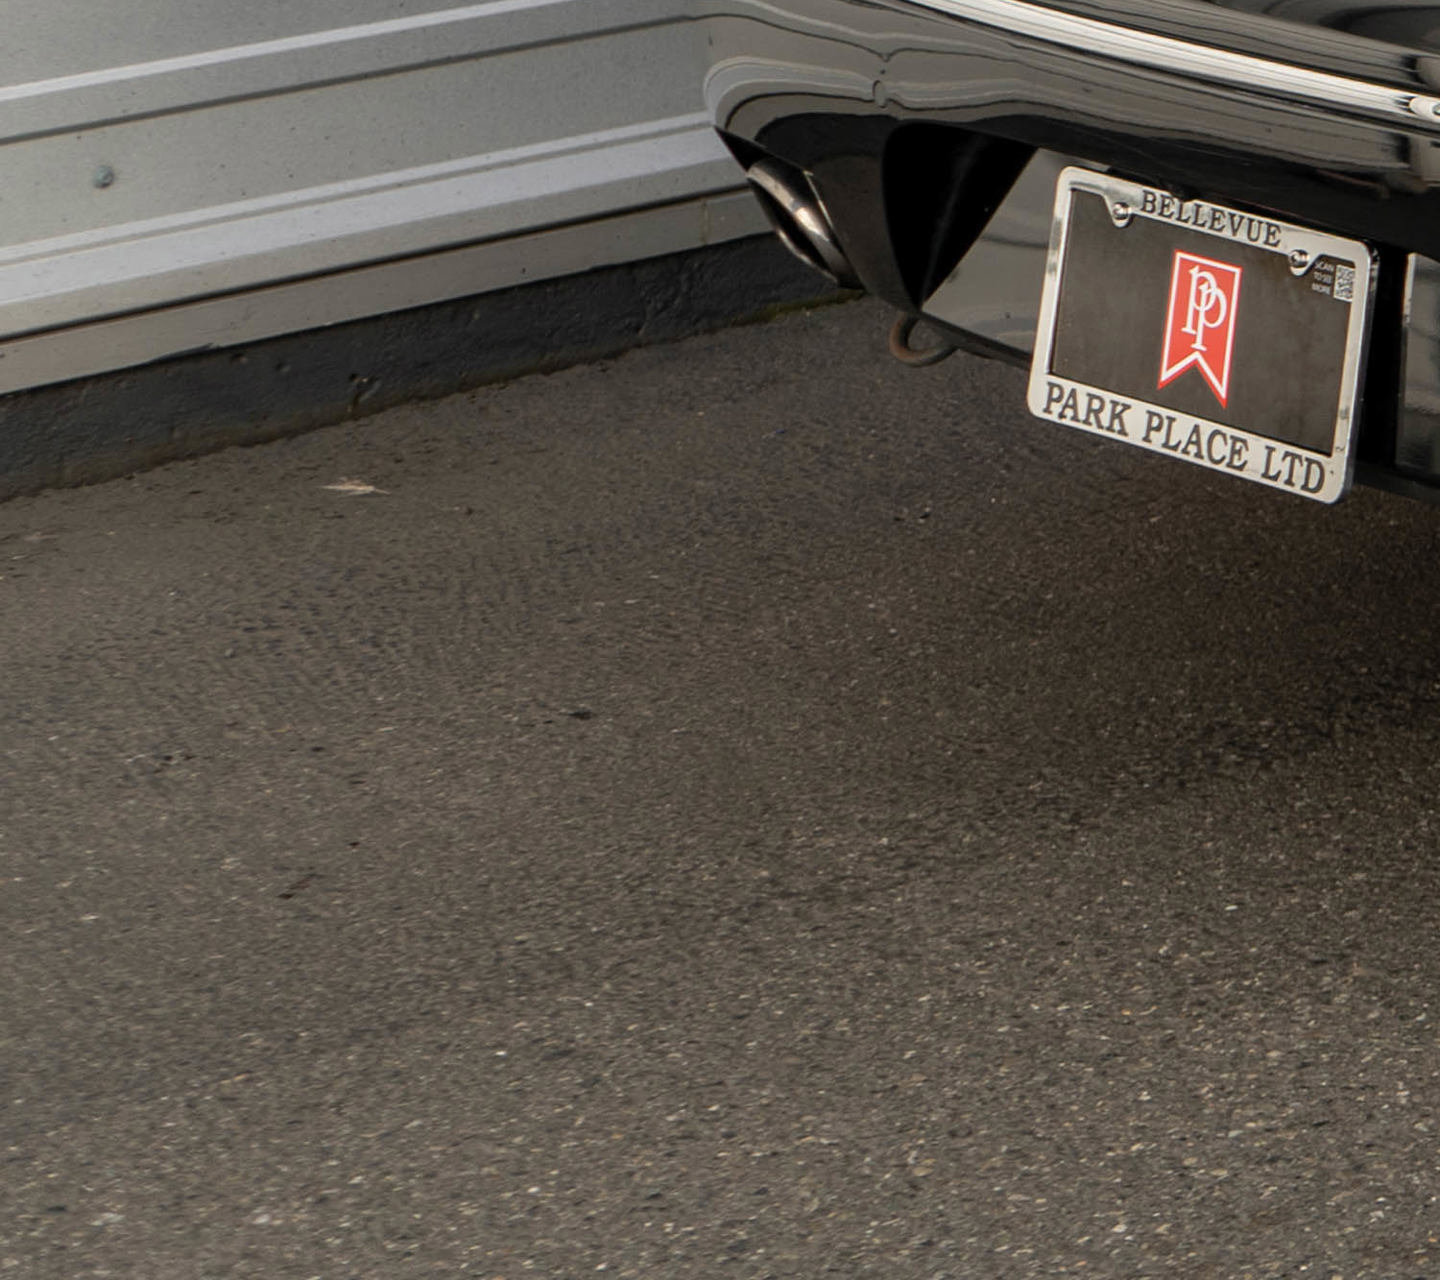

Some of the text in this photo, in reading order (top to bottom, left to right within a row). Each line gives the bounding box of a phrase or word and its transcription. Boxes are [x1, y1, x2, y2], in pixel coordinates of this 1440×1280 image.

[1140, 189, 1281, 248] BELLEVUE
[1042, 381, 1326, 494] PARK PLACE LTD
